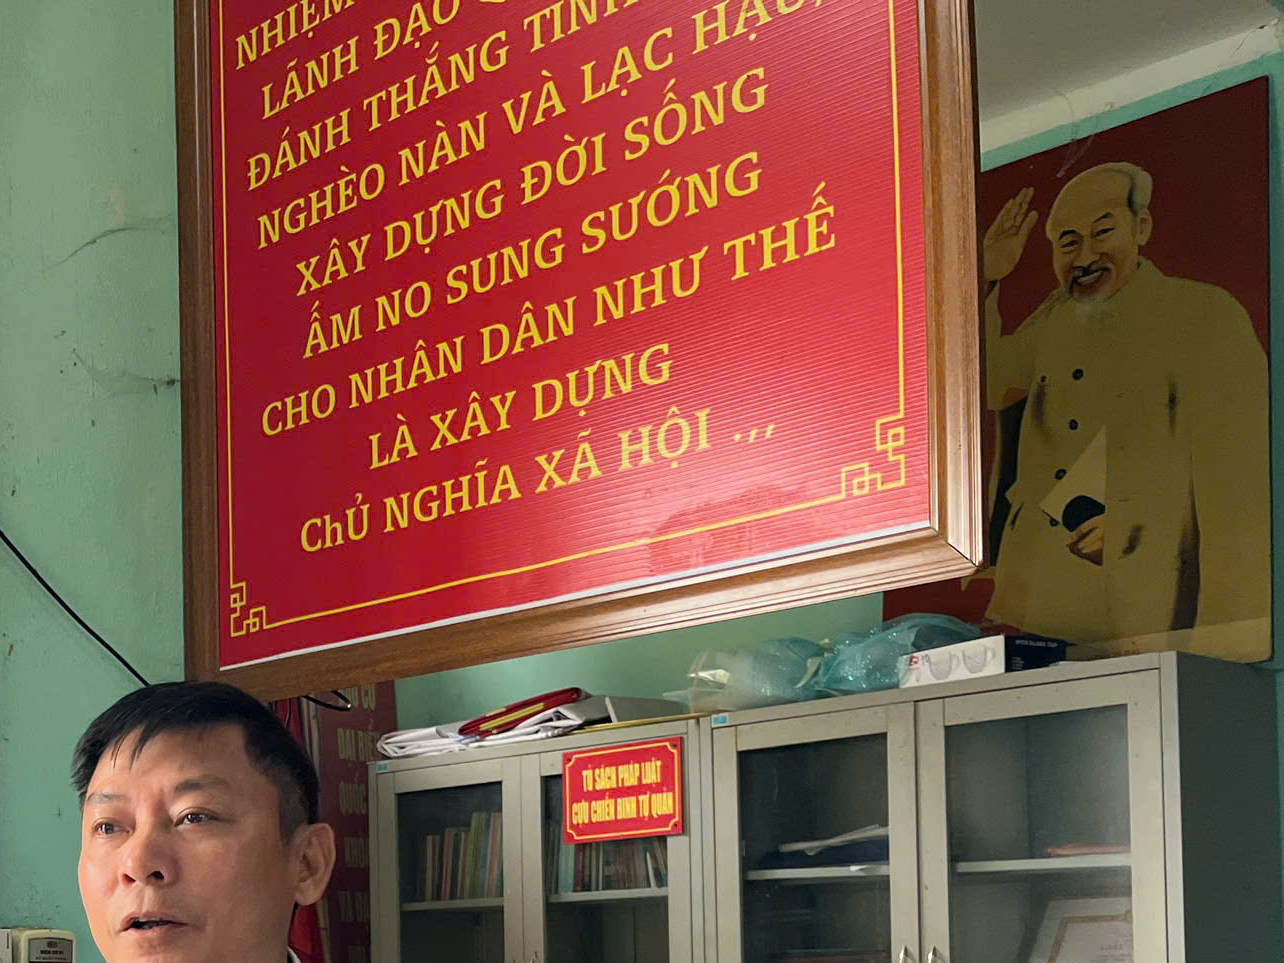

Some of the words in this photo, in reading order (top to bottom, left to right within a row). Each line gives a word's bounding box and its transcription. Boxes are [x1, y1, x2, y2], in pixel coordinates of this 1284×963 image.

[247, 109, 351, 191] ĐÁNH
[364, 31, 509, 132] THẮNG
[262, 36, 359, 119] LÃNH
[373, 0, 460, 60] ĐẠO
[257, 164, 385, 249] NGHÈO
[399, 112, 487, 185] NÀN
[502, 70, 567, 135] VÀ
[582, 27, 674, 104] LẠC
[296, 234, 370, 297] XÂY
[384, 180, 505, 261] DỰNG
[520, 133, 607, 205] ĐỜI
[624, 67, 769, 160] SỐNG
[262, 384, 336, 436] CHO
[349, 336, 464, 409] NHÂN
[480, 297, 576, 365] DÂN
[593, 246, 709, 327] NHƯ
[724, 182, 837, 281] THẾ
[303, 301, 363, 359] ẤM
[376, 282, 432, 332] NO
[447, 228, 565, 305] SUNG
[581, 152, 763, 254] SƯỚNG
[368, 413, 419, 469] LÀ
[431, 391, 517, 451] XÂY
[531, 344, 673, 421] DỰNG
[383, 460, 522, 533] NGHĨA
[535, 429, 604, 494] XÃ
[620, 407, 713, 473] HỘI
[582, 764, 594, 793] TỦ
[595, 764, 618, 791] SÁCH
[618, 760, 641, 788] PHÁP
[641, 757, 662, 788] LUẬT
[591, 792, 616, 824] CHIẾN
[617, 797, 637, 820] BINH
